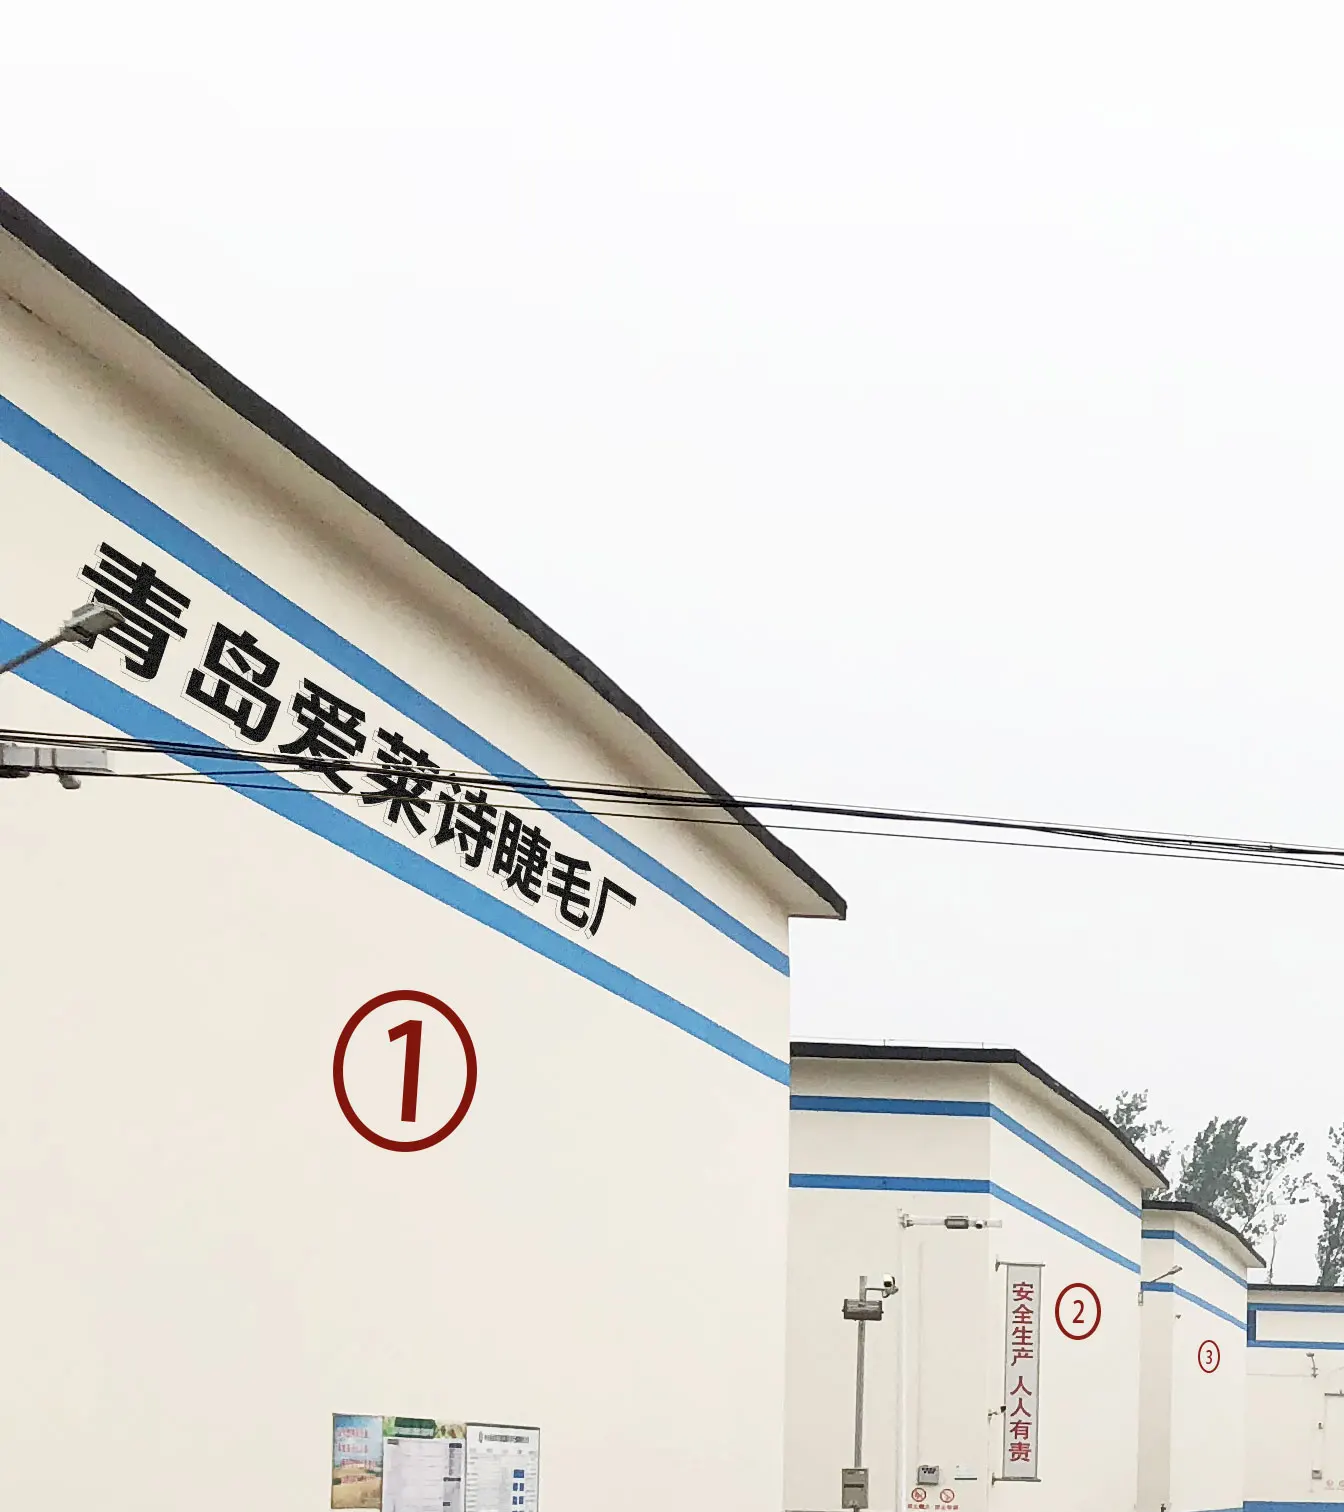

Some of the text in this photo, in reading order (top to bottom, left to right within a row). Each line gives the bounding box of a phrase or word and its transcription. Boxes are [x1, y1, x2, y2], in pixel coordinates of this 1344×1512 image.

[76, 541, 637, 937] 青岛爱莱诗睫毛厂
[387, 1019, 423, 1123] 1
[1009, 1282, 1034, 1463] 安全生产 人人有责
